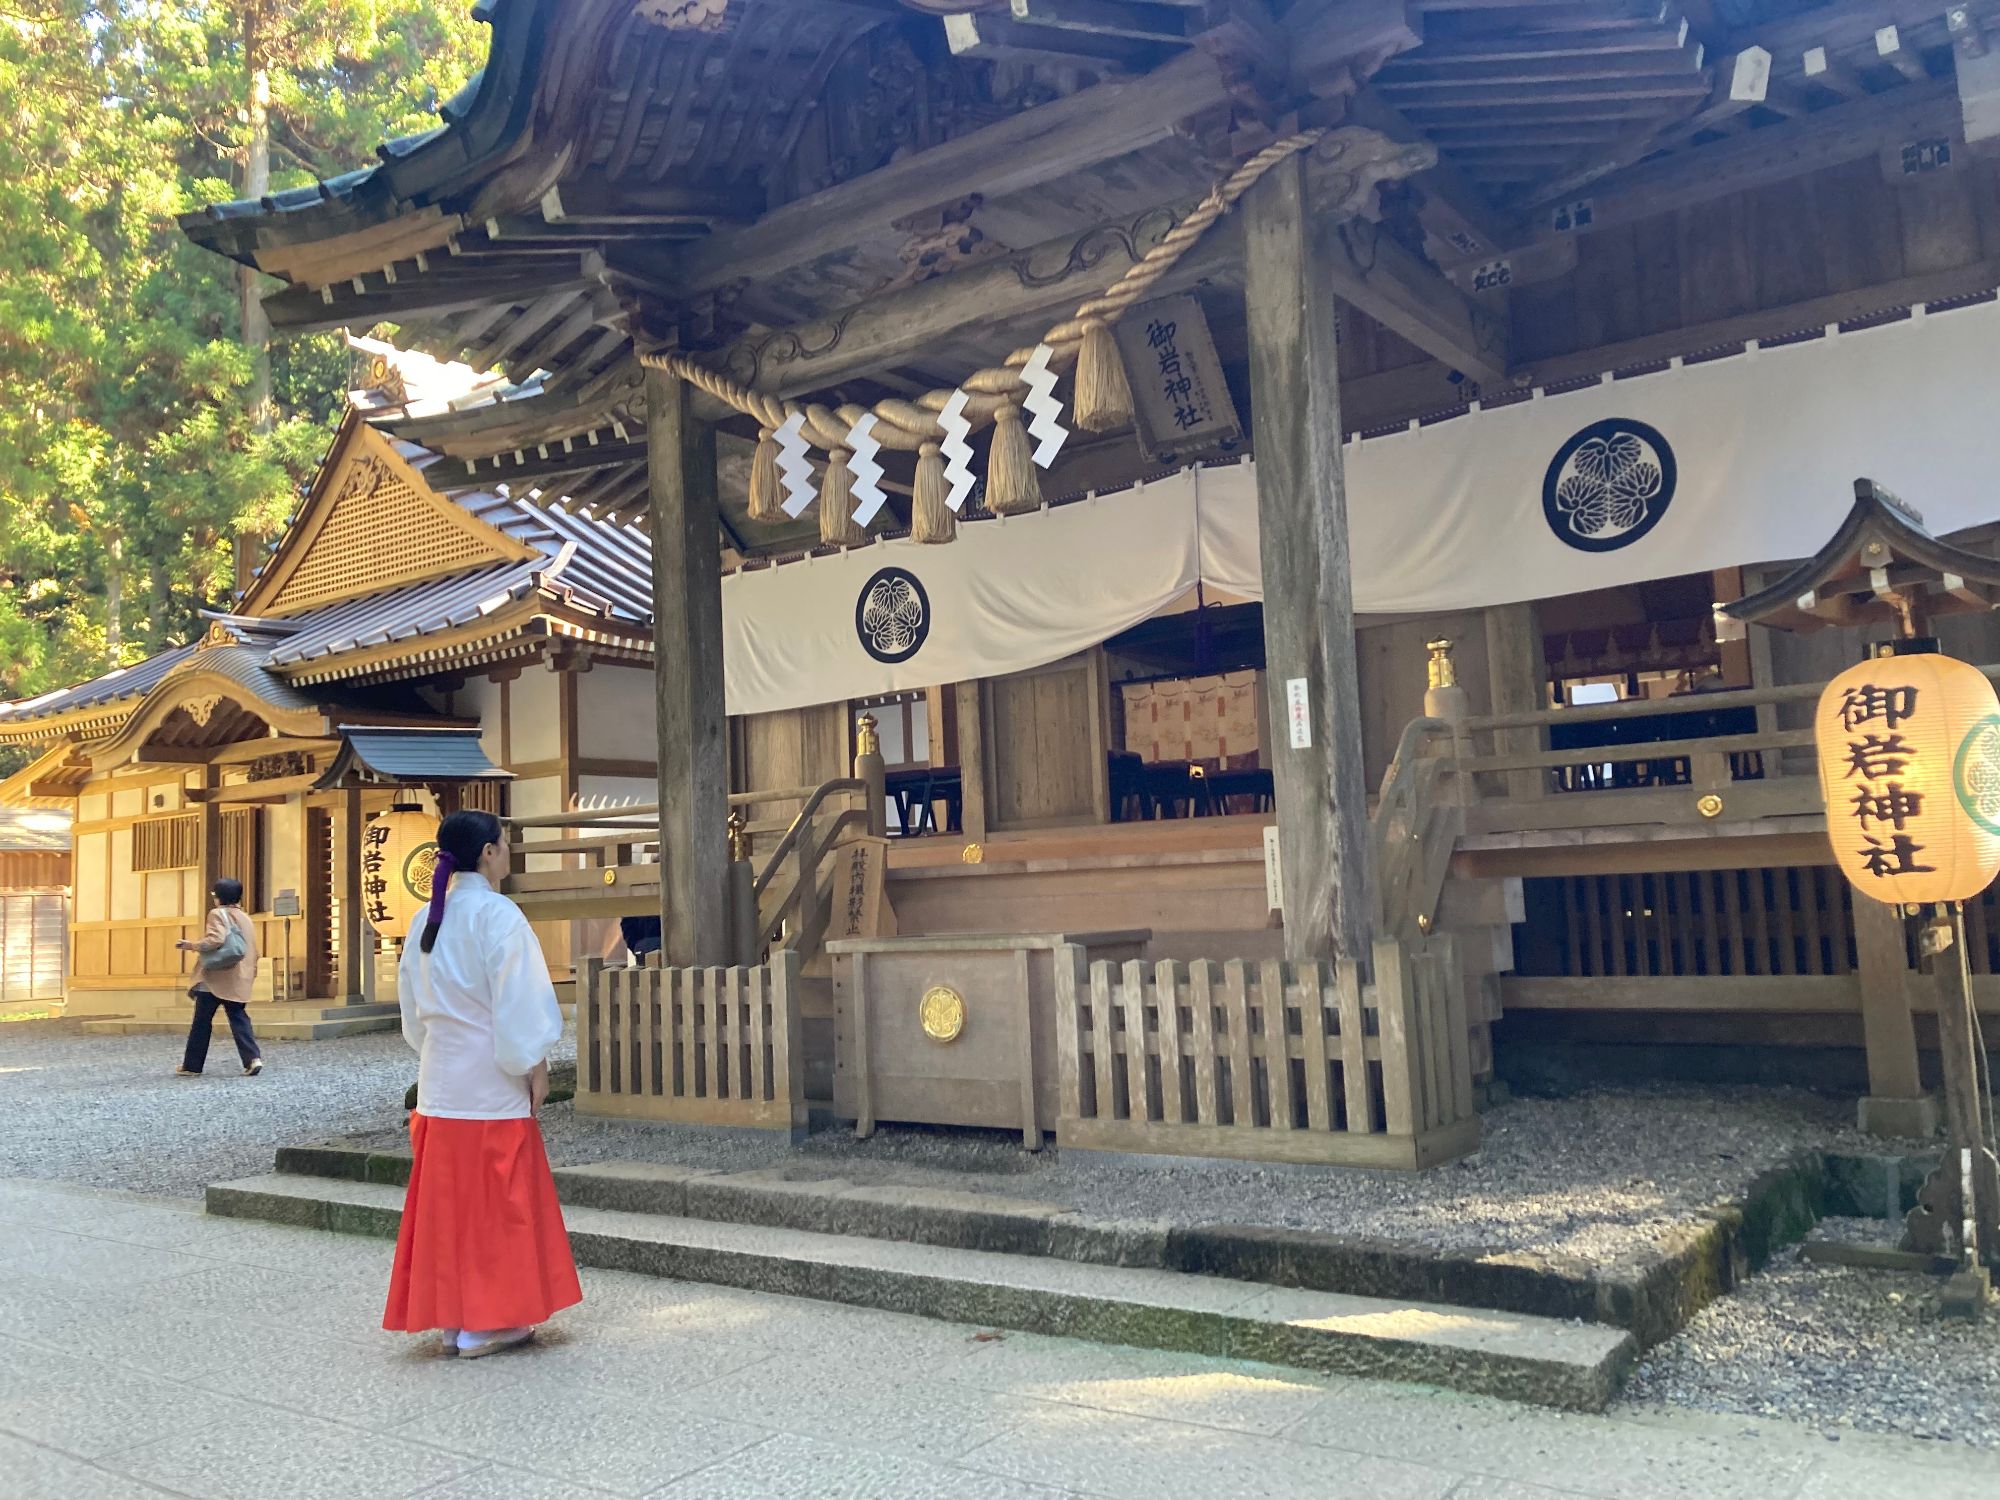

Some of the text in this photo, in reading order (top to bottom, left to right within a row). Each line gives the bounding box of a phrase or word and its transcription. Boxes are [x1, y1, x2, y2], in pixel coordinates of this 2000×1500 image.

[1146, 319, 1204, 430] 御岩神社
[1837, 684, 1936, 877] 御岩神社
